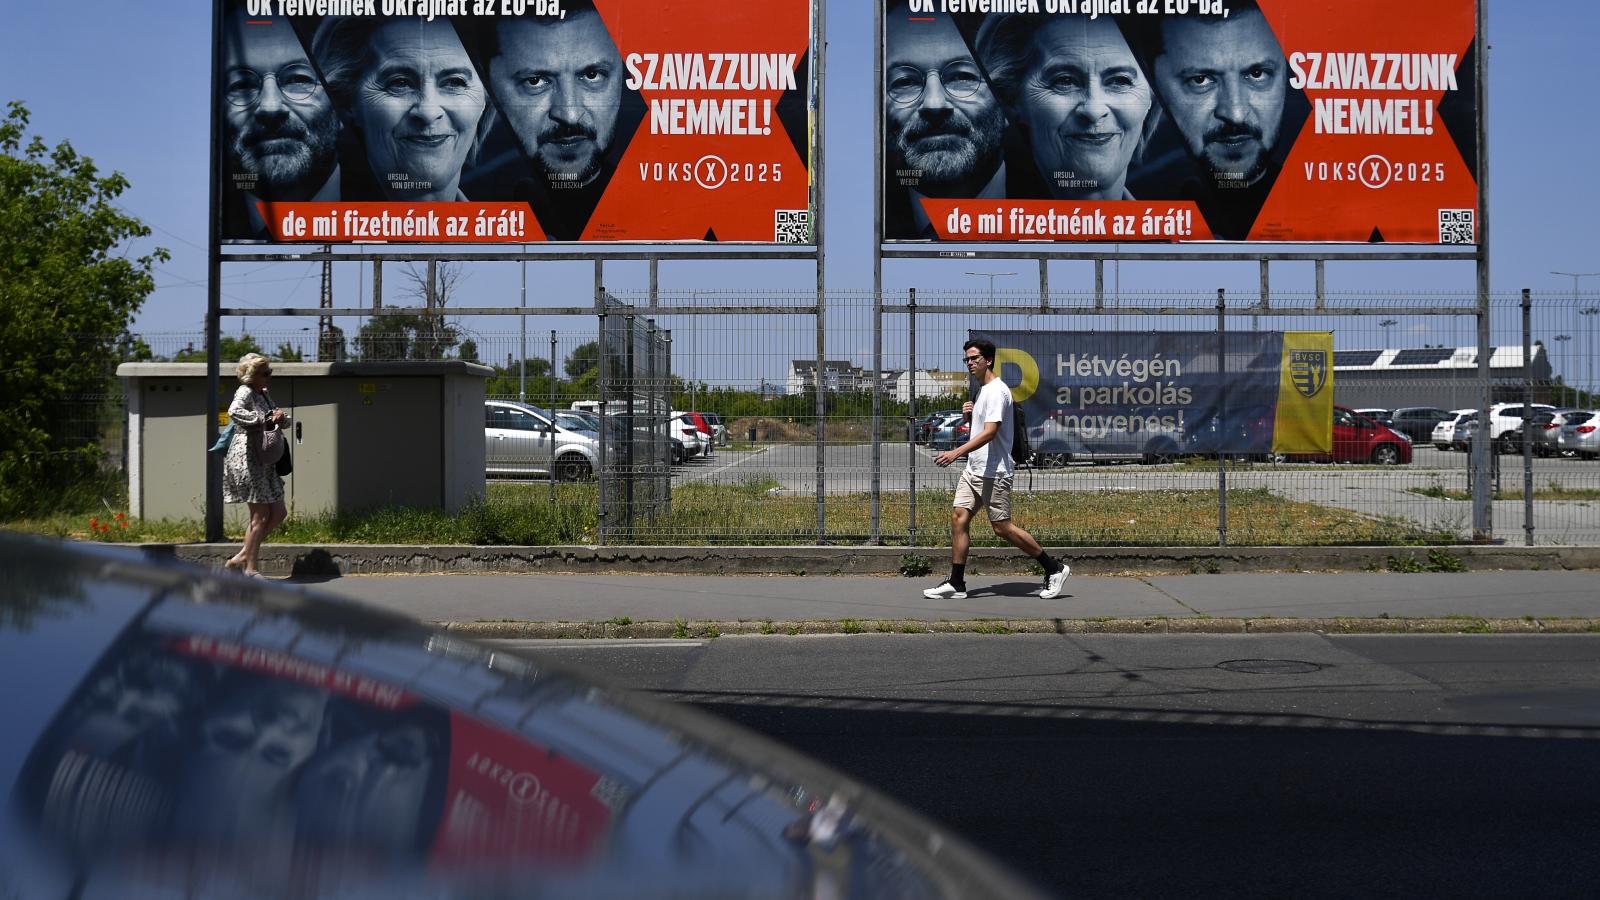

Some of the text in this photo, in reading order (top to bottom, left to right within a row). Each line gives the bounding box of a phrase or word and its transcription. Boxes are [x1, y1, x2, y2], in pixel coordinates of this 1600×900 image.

[472, 0, 496, 16] az
[625, 53, 797, 91] SZAVAZZUNK
[1289, 52, 1458, 91] SZAVAZZUNK
[650, 99, 771, 135] NEMMEL!
[1314, 98, 1434, 135] NEMMEL!
[387, 173, 409, 181] URSULA
[391, 181, 403, 190] VON
[403, 181, 415, 190] DER
[639, 162, 692, 182] VOKS
[730, 163, 782, 182] 2025
[1053, 171, 1075, 179] URSULA
[1057, 179, 1098, 188] VON DER LEYEN
[1304, 162, 1356, 181] VOKS
[1394, 163, 1445, 181] 2025
[282, 209, 525, 237] de mi fizetnénk az árát!
[947, 207, 1192, 236] de mi fizetnénk az árát!
[1056, 353, 1181, 383] Hétvégén
[1295, 353, 1321, 361] BVSC
[1056, 381, 1193, 410] a parkolás
[1055, 409, 1185, 439] ingyenes!
